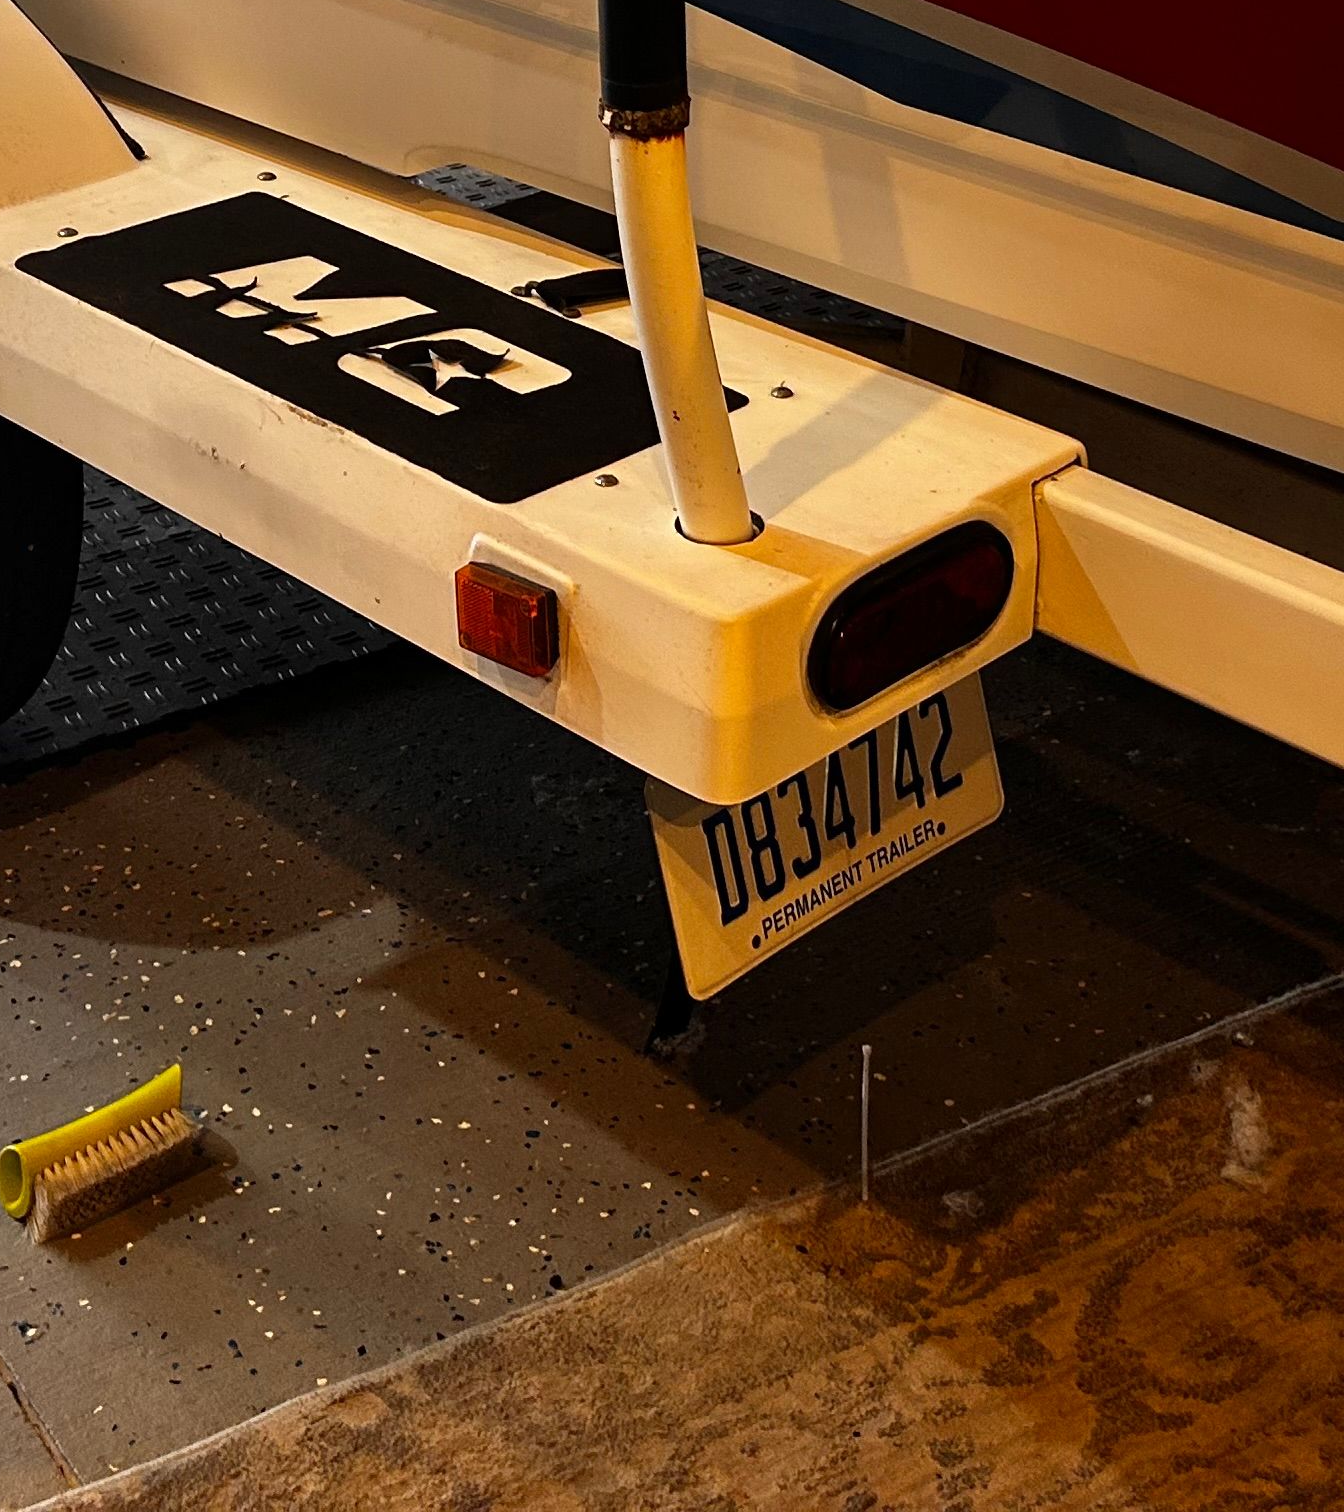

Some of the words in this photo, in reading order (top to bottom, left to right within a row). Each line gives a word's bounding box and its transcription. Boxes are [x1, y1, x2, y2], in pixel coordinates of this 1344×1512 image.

[701, 690, 964, 927] D834742
[761, 860, 864, 940] PERMANENT
[865, 818, 938, 875] TRAILER
